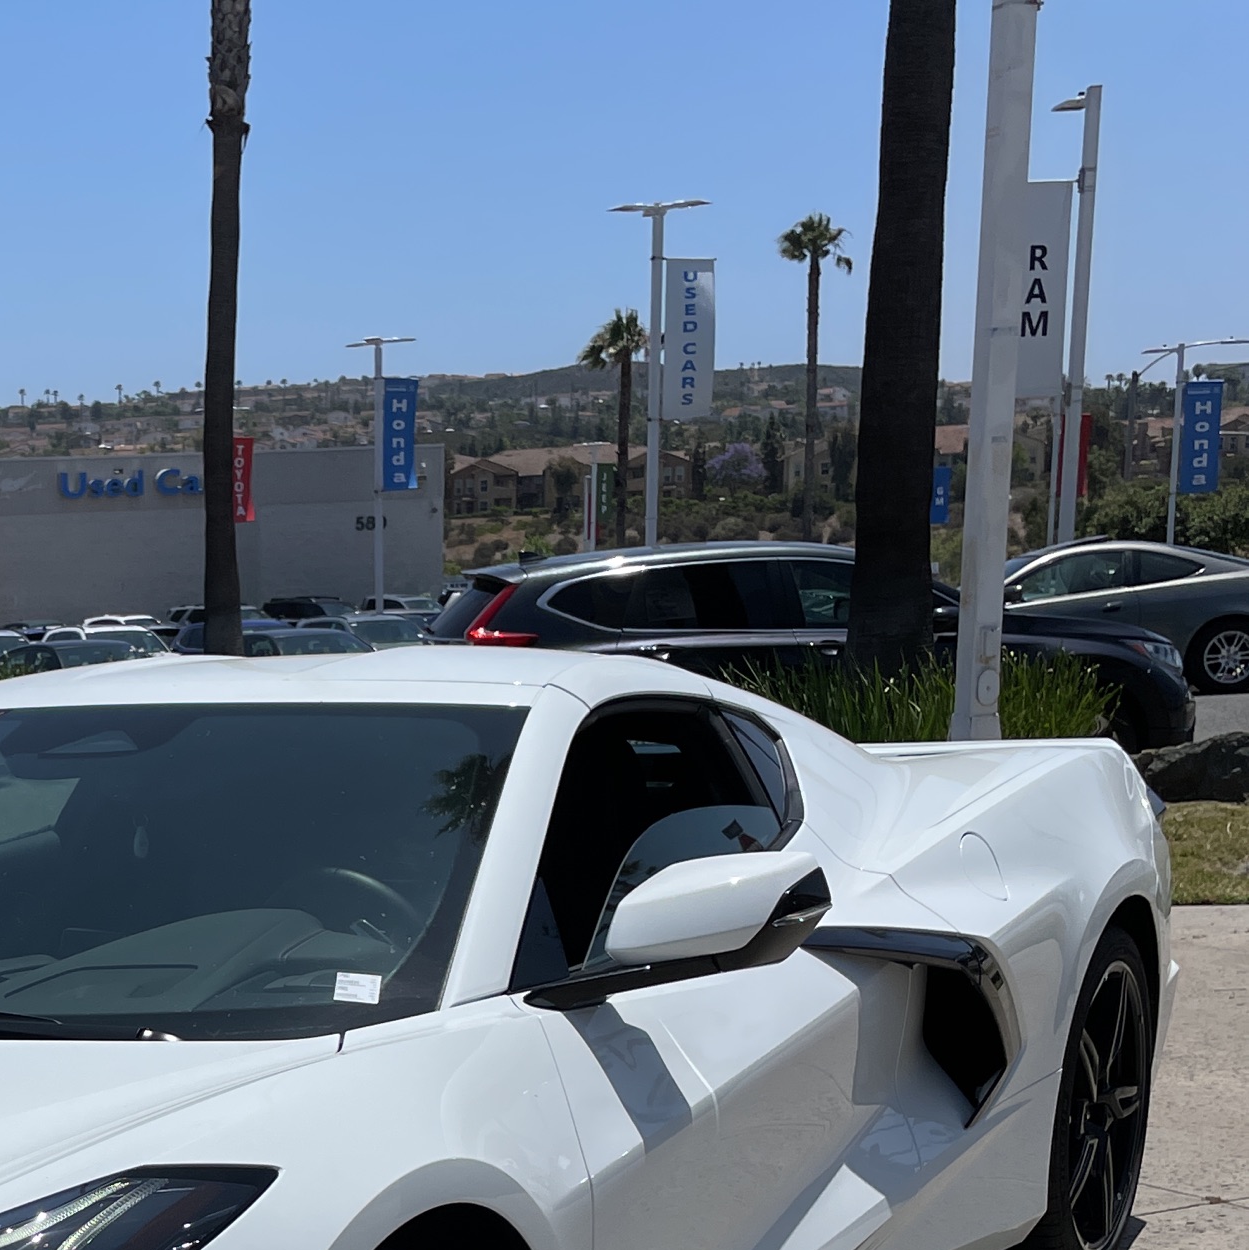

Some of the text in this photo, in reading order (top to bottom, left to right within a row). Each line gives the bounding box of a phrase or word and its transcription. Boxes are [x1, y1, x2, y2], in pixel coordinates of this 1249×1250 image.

[1019, 244, 1050, 338] RAM
[681, 270, 698, 406] USED CARS
[233, 444, 247, 517] TOYOTA
[391, 399, 408, 483] Honda
[1192, 400, 1212, 486] Honda
[59, 469, 145, 499] Used
[935, 486, 945, 506] GM
